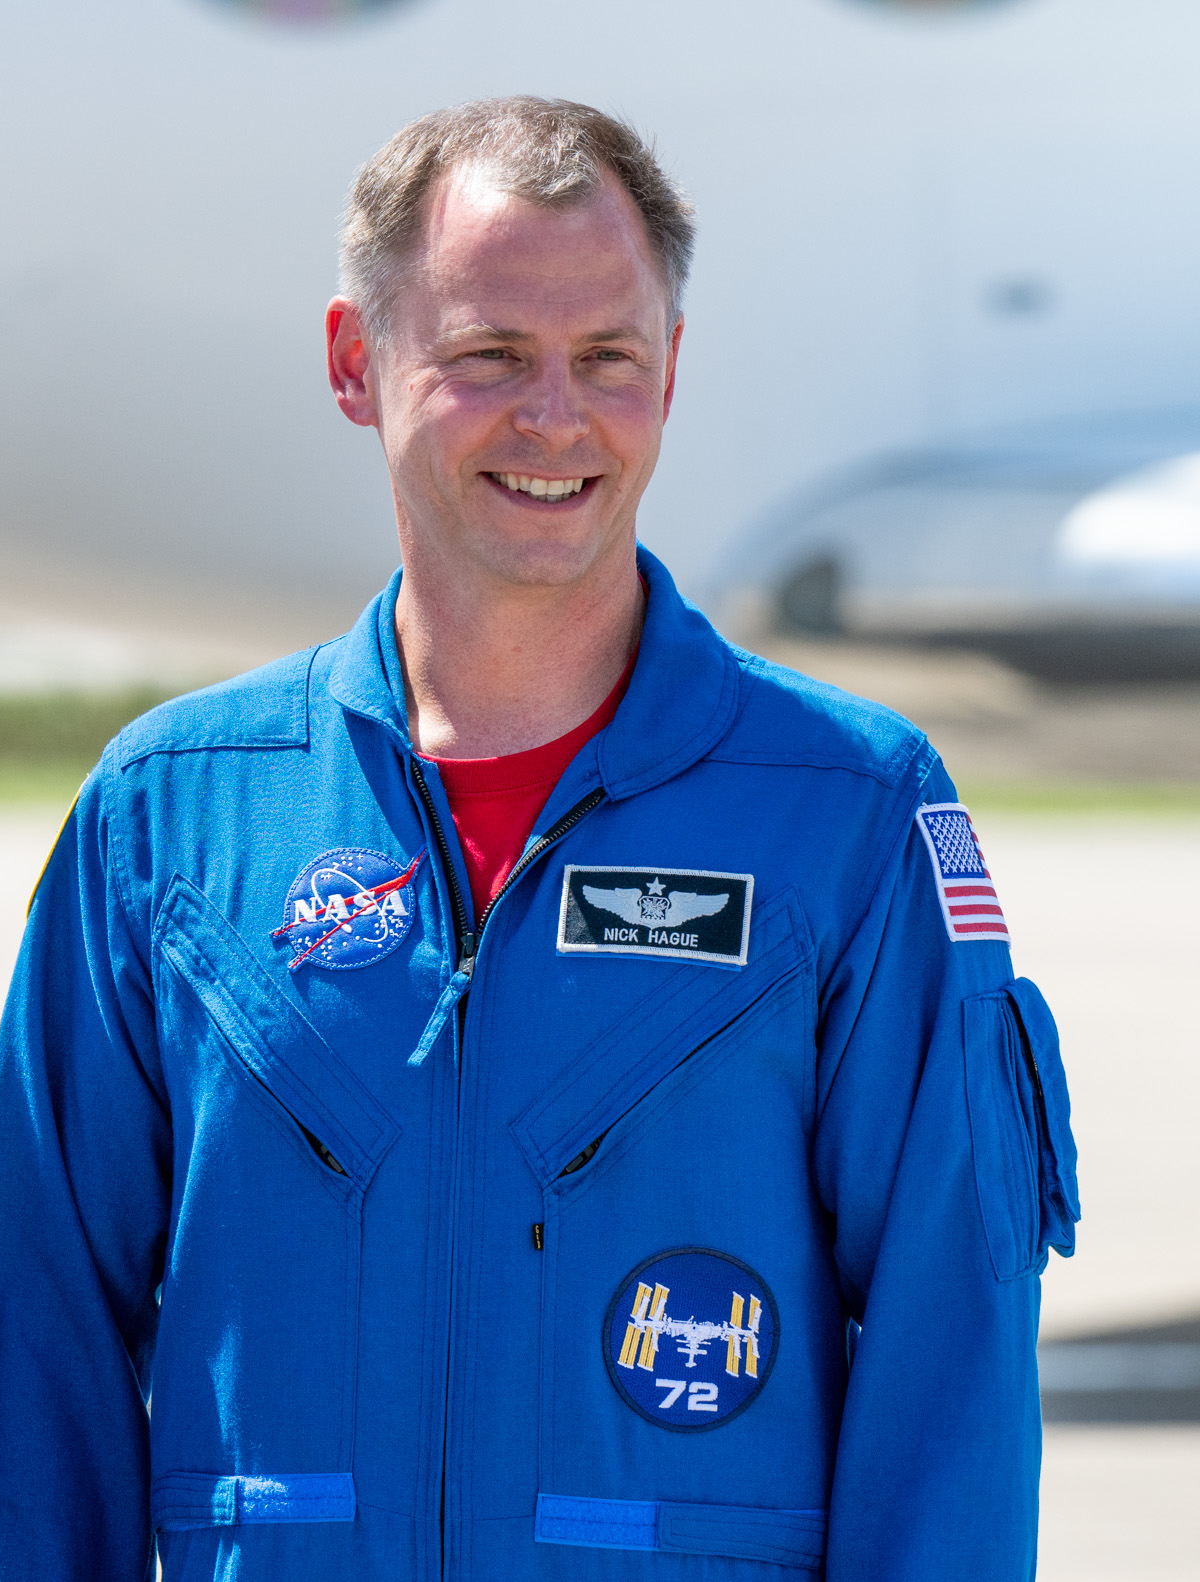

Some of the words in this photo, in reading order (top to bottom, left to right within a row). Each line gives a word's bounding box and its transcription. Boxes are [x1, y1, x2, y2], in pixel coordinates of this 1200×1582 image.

[294, 890, 409, 925] NASA
[604, 927, 639, 943] NICK
[648, 930, 699, 947] HAGUE
[655, 1378, 719, 1412] 72
